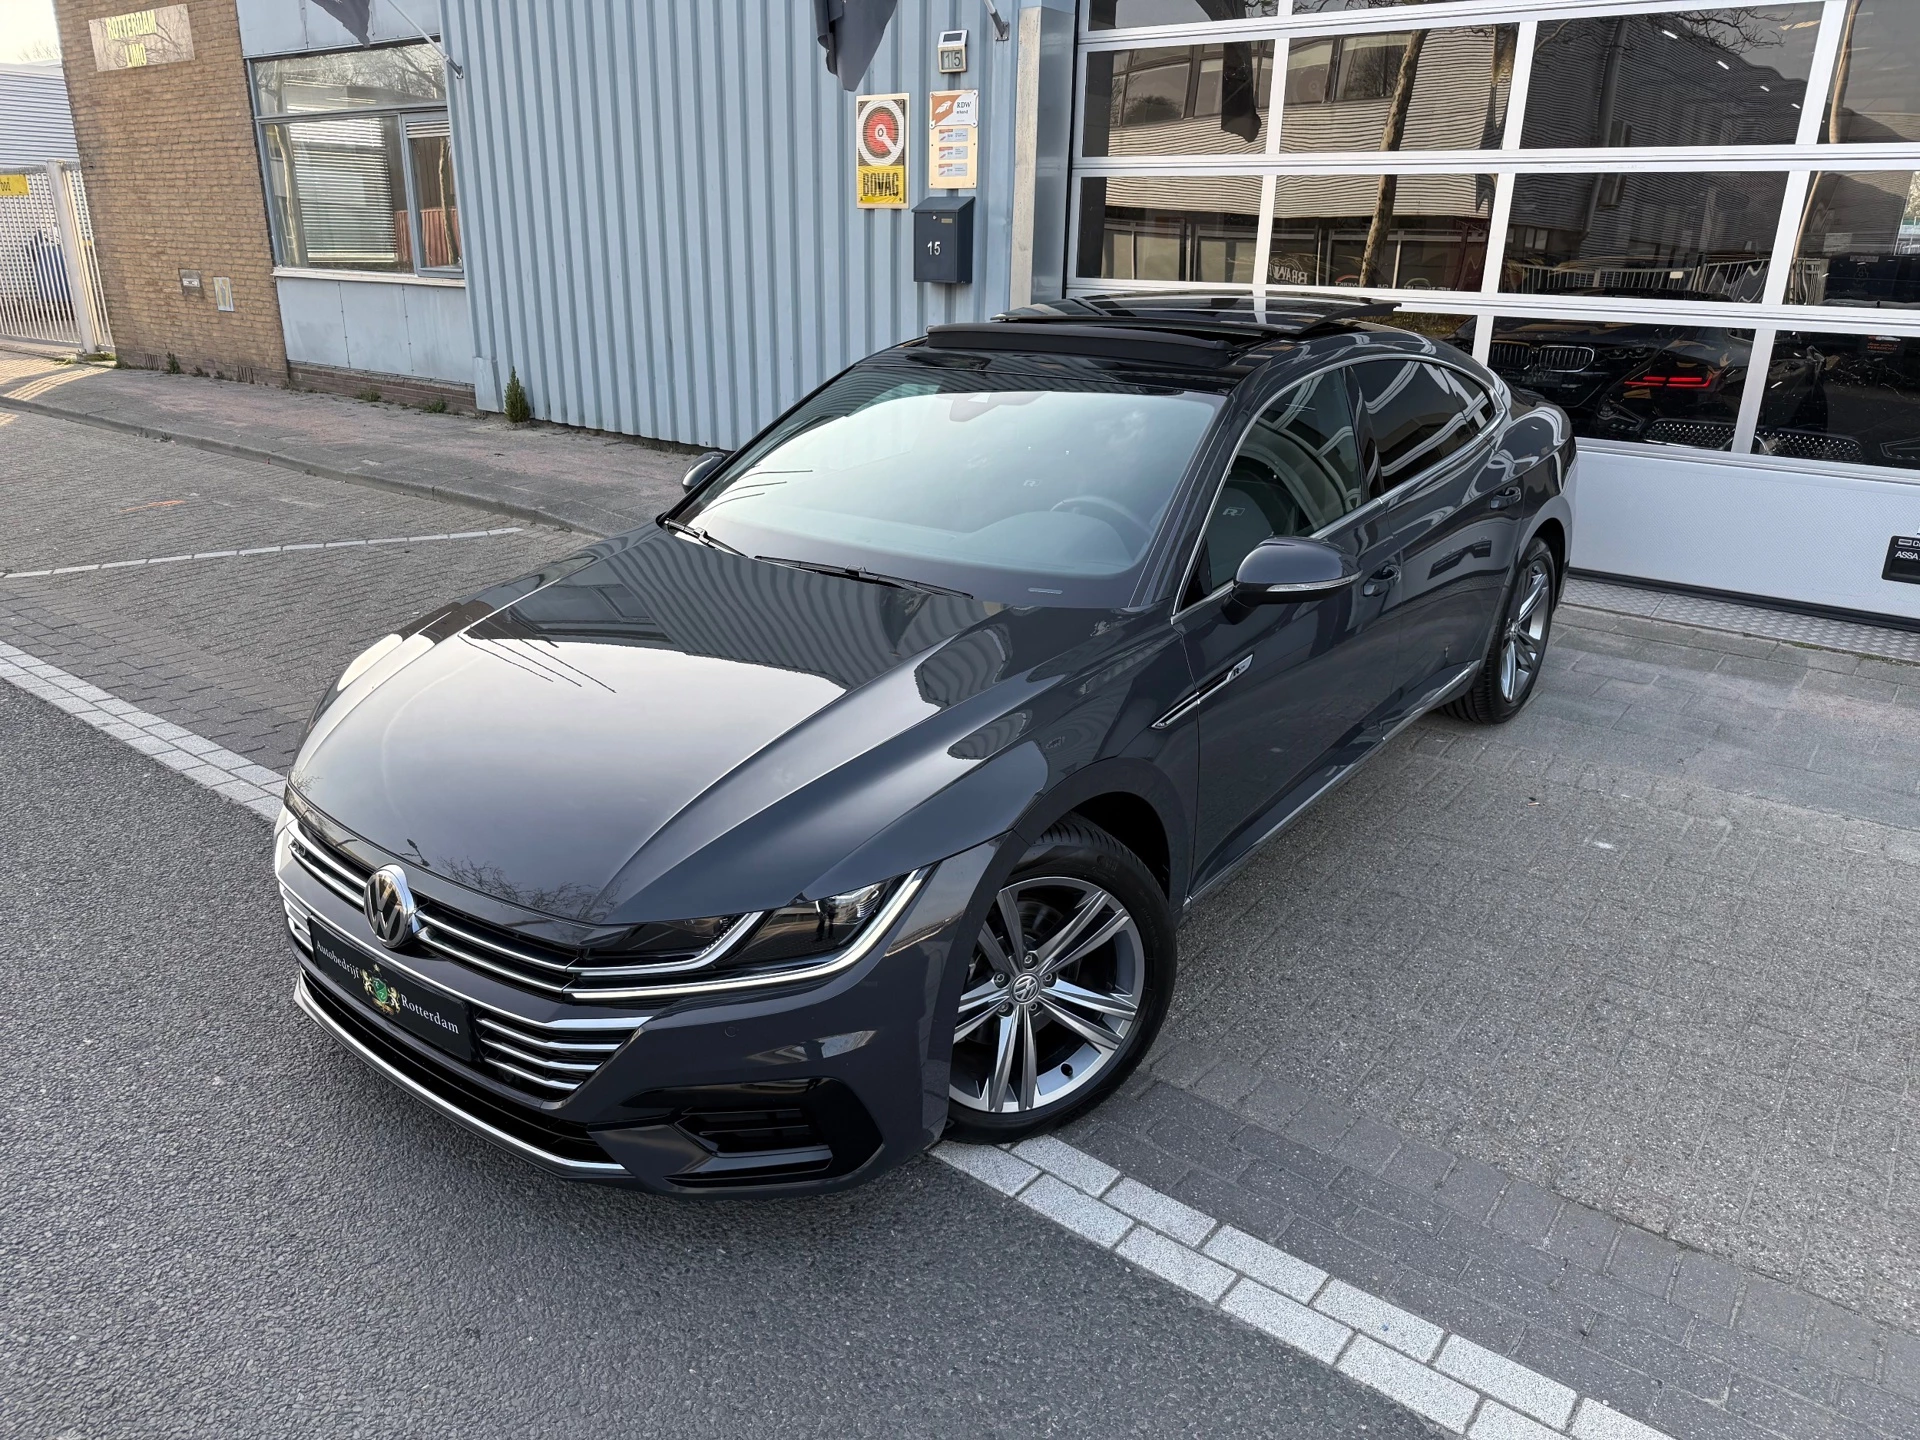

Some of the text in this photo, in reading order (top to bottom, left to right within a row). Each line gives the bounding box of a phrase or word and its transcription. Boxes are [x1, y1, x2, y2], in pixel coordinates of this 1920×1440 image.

[105, 9, 157, 40] ROTTERDAM
[125, 42, 147, 67] LIMO
[945, 51, 961, 67] 15
[956, 101, 972, 109] RDW
[927, 240, 941, 256] 15
[1895, 550, 1919, 561] ASSA
[316, 939, 360, 979] Autobedrijf
[401, 994, 460, 1034] Rotterdam
